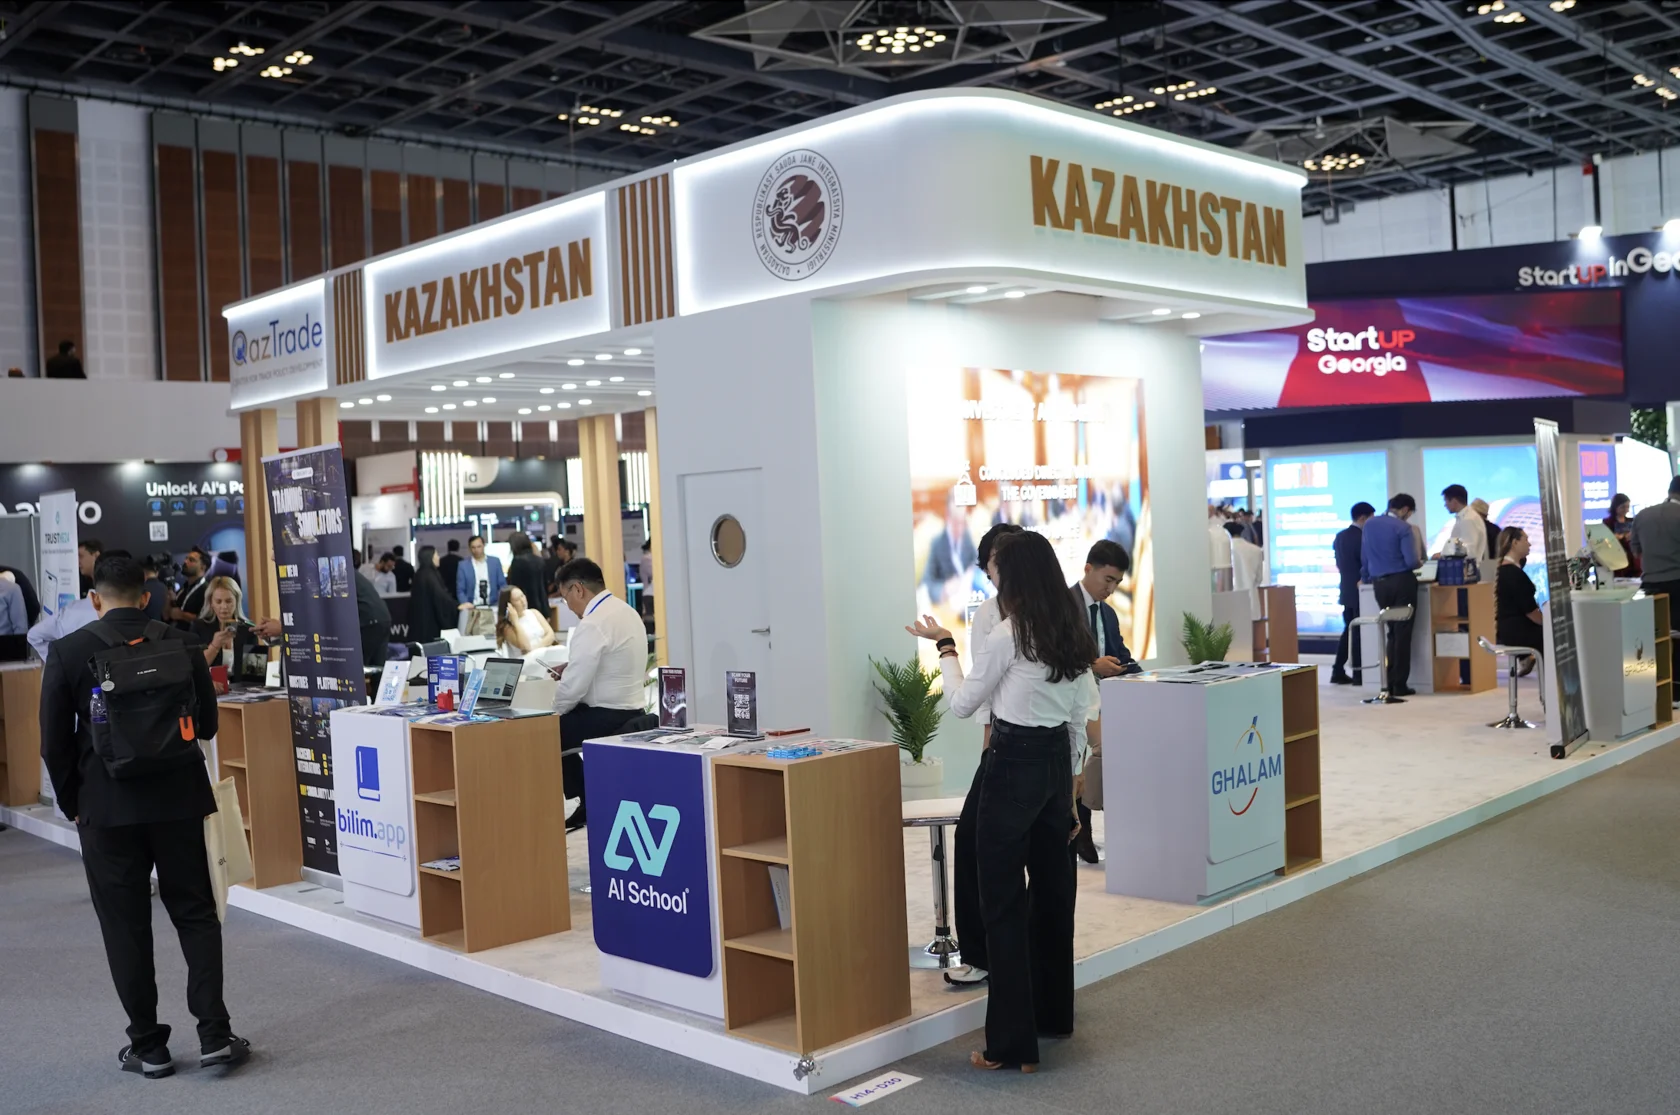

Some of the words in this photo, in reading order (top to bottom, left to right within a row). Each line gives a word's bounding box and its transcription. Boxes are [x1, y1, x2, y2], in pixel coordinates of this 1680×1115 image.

[775, 155, 797, 174] SAUDA
[800, 153, 816, 166] JANE
[818, 161, 841, 219] INTEGRATSIYA
[1030, 155, 1287, 268] KAZAKHSTAN
[1518, 264, 1606, 286] StartUP
[385, 238, 592, 343] KAZAKHSTAN
[232, 312, 322, 366] QazTrade
[1307, 326, 1416, 353] StartUP
[1318, 352, 1407, 377] Georgia
[146, 481, 198, 497] Unlock
[201, 481, 227, 496] AI's
[272, 486, 304, 514] TRAINING
[1002, 486, 1019, 501] THE
[298, 507, 343, 537] SIMULATORS
[1212, 753, 1281, 795] GHALAM
[337, 808, 406, 849] bilim.app
[608, 877, 624, 901] AI
[851, 1077, 902, 1100] H14-D30
